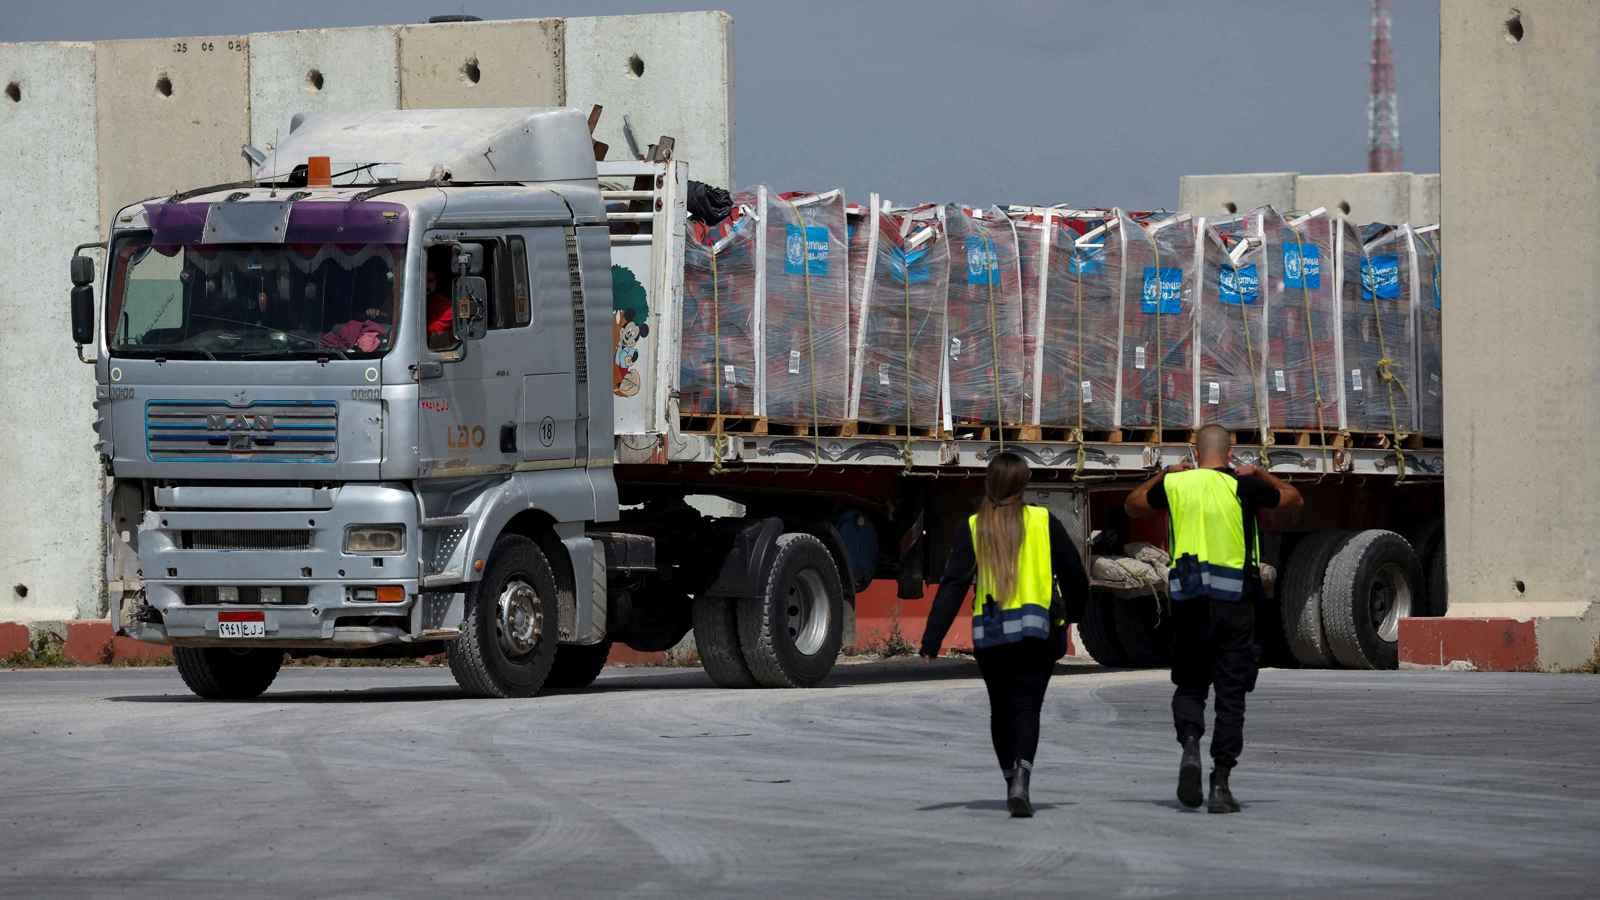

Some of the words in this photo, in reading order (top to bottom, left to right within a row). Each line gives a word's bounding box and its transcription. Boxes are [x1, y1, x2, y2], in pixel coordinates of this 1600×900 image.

[201, 42, 214, 52] 06
[207, 414, 272, 431] MAN
[542, 423, 553, 440] 18
